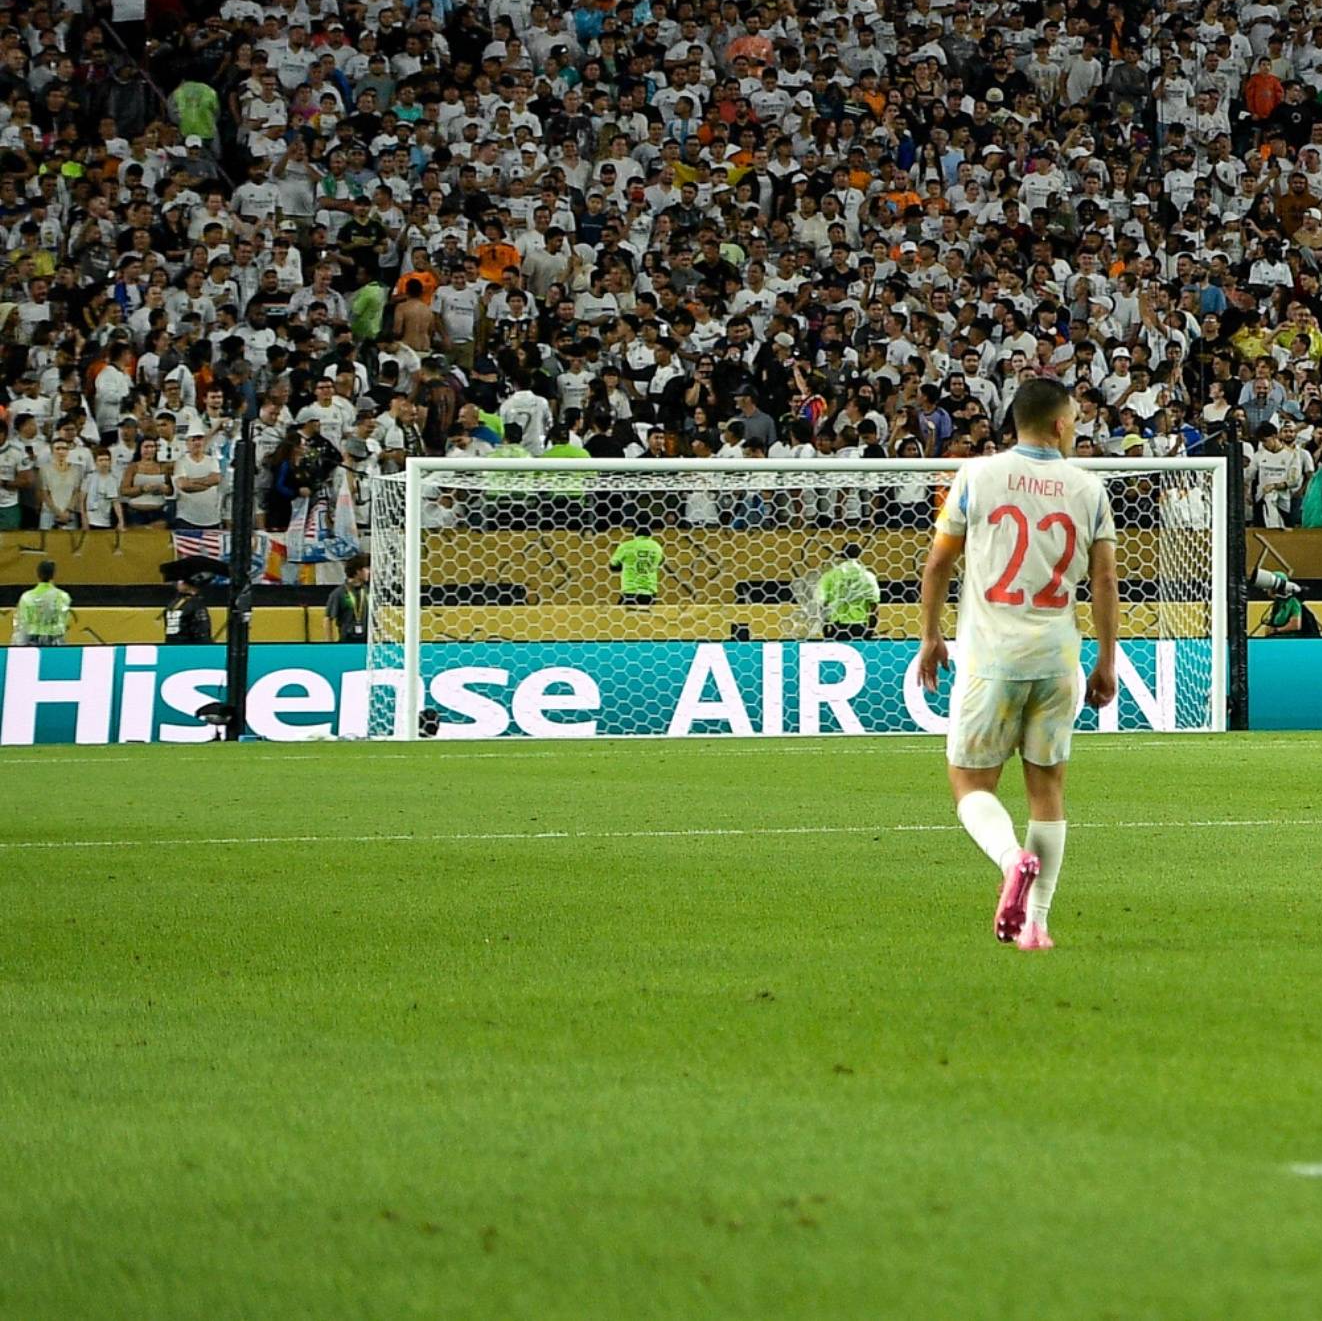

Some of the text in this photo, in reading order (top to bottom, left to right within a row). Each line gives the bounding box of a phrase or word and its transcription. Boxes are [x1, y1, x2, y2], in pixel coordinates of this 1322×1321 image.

[1008, 473, 1065, 497] LAINER
[984, 504, 1077, 608] 22
[0, 640, 1176, 746] Hisense AIR CN
